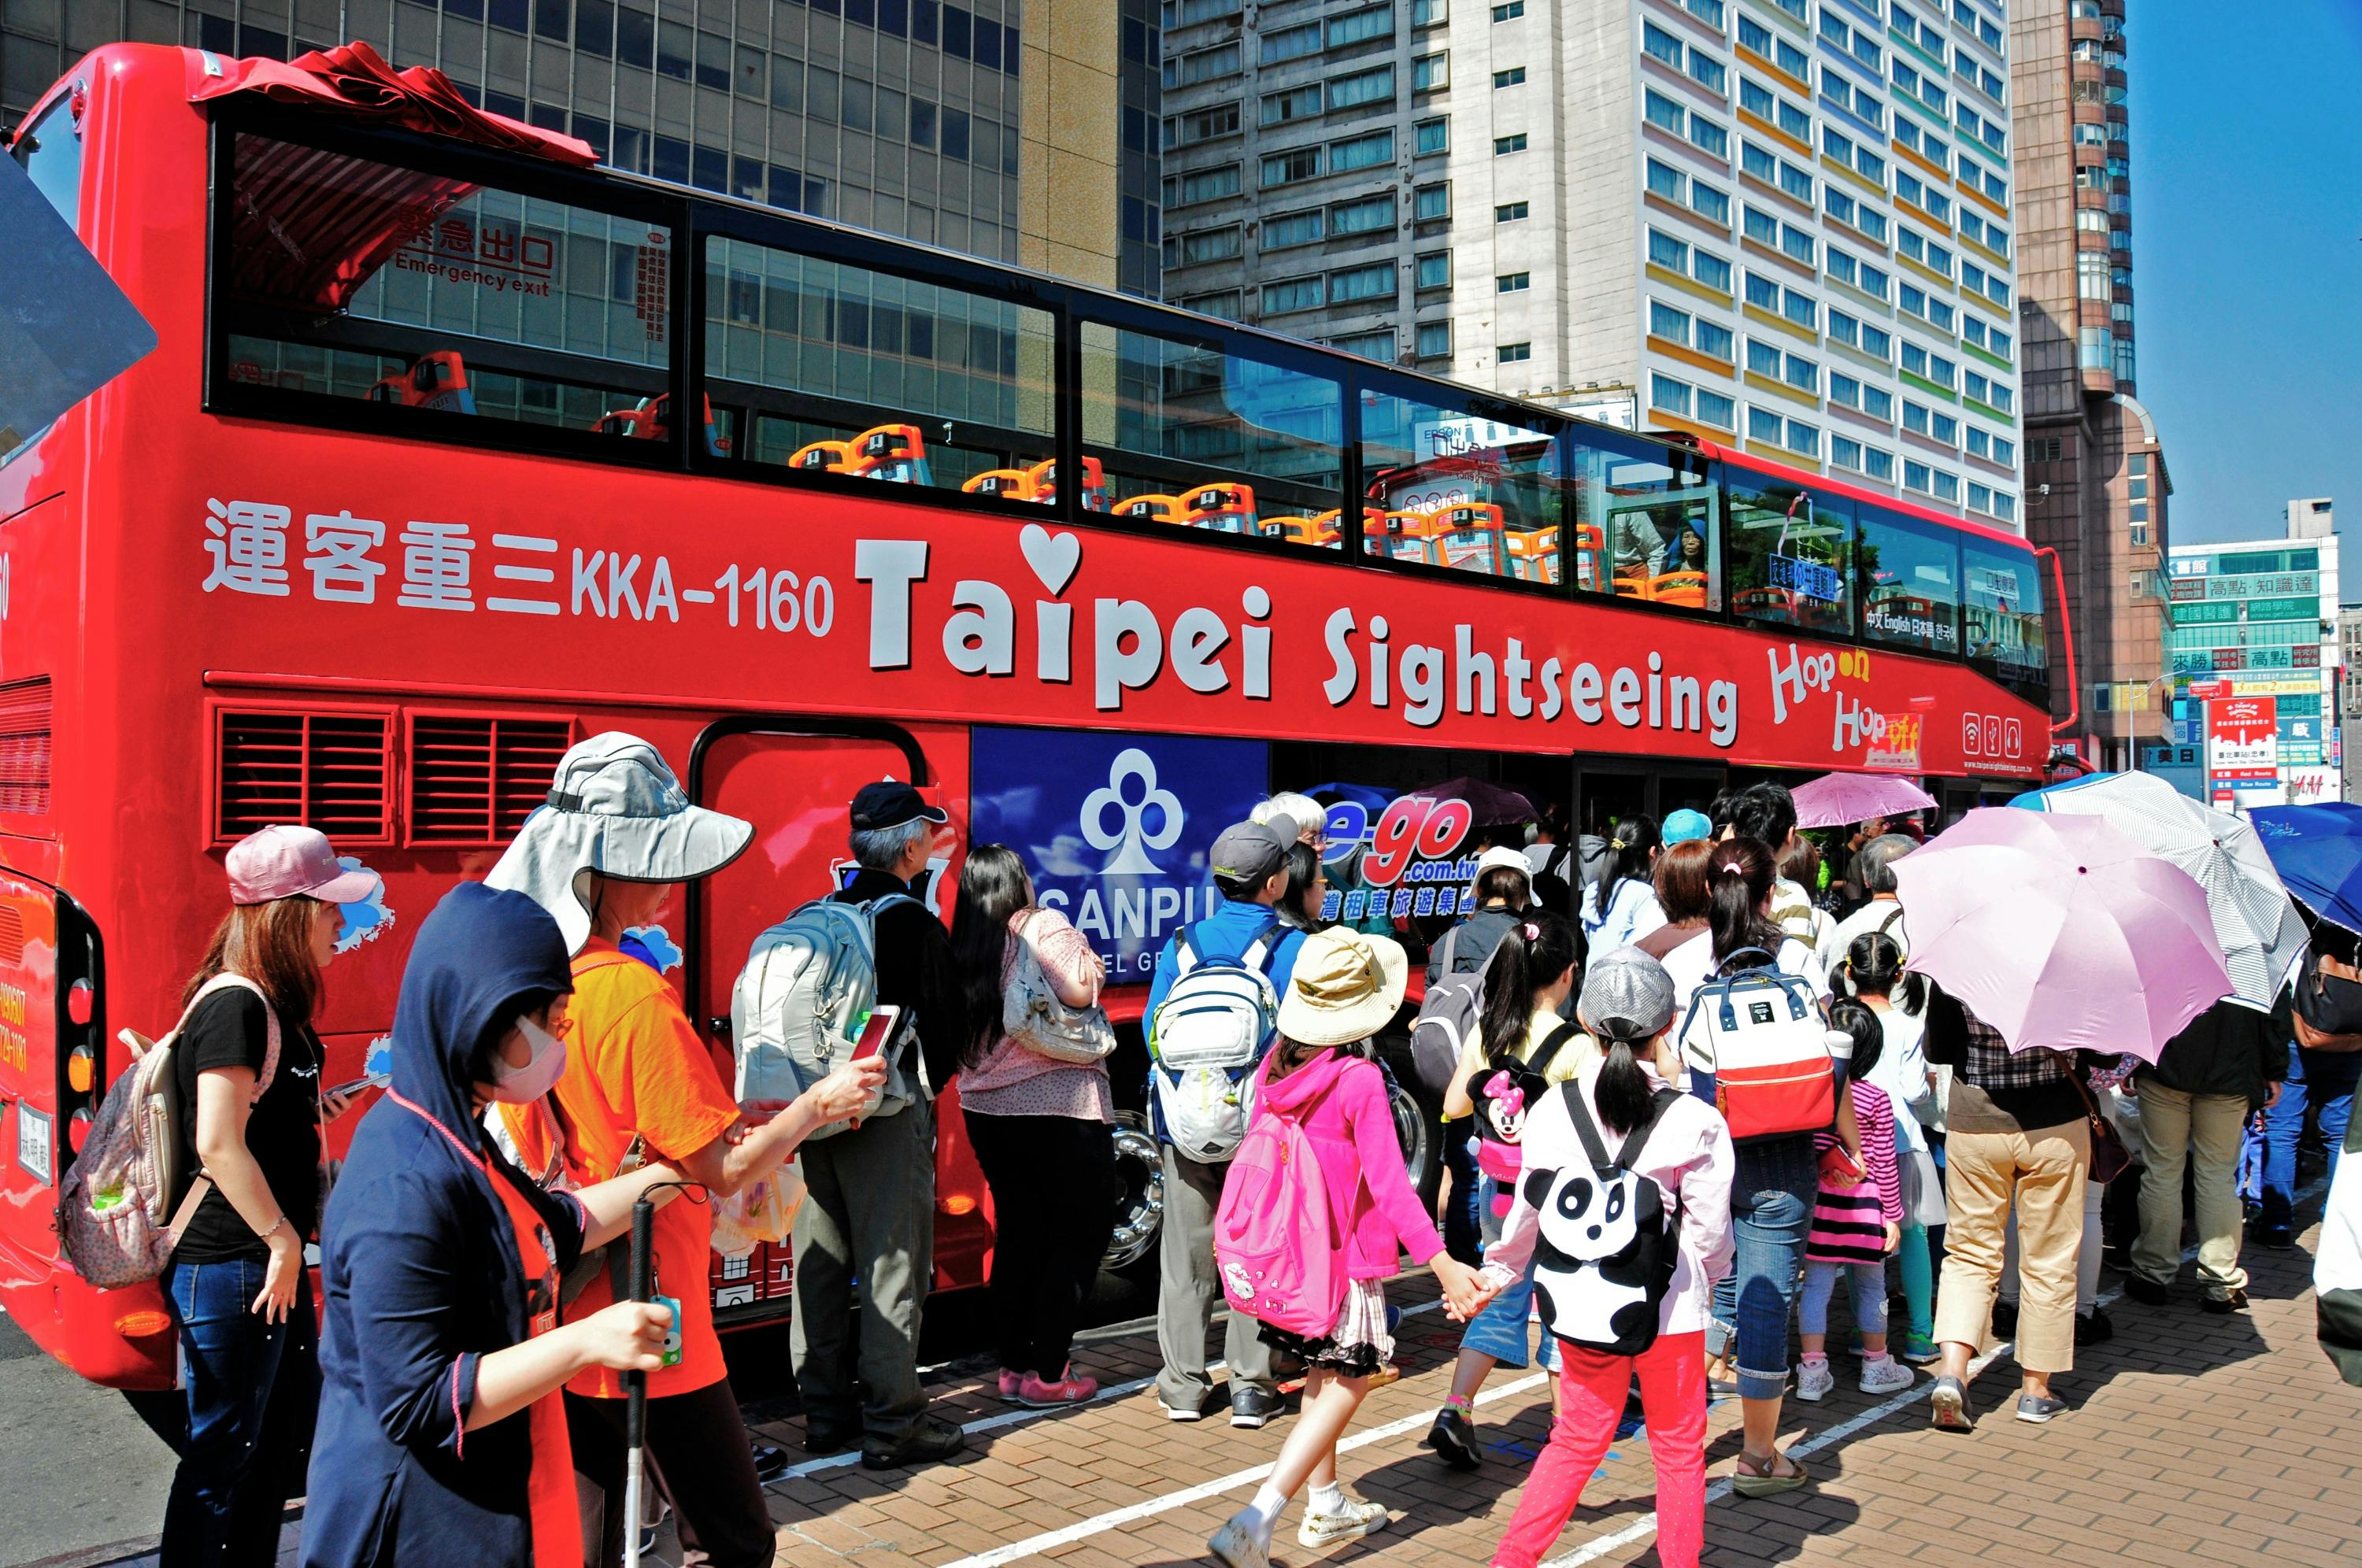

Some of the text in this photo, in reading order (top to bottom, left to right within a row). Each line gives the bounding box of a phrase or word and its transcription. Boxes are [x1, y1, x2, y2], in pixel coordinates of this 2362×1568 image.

[395, 252, 549, 298] Emergency exit
[1424, 427, 1461, 439] EPSON
[0, 552, 9, 621] 0
[572, 548, 835, 638] KKA-1160
[1866, 612, 1883, 630] 中文
[1884, 615, 1911, 634] English
[2173, 605, 2231, 621] 建國醫護
[855, 523, 1738, 746] Taipei Sightseeing
[1912, 619, 1934, 638] 日本語
[1935, 623, 1957, 642] 한국어
[2251, 651, 2288, 667] 高點
[1768, 643, 1869, 724] Hop on
[1832, 691, 1919, 761] Hop off
[1404, 854, 1479, 882] .com.tw
